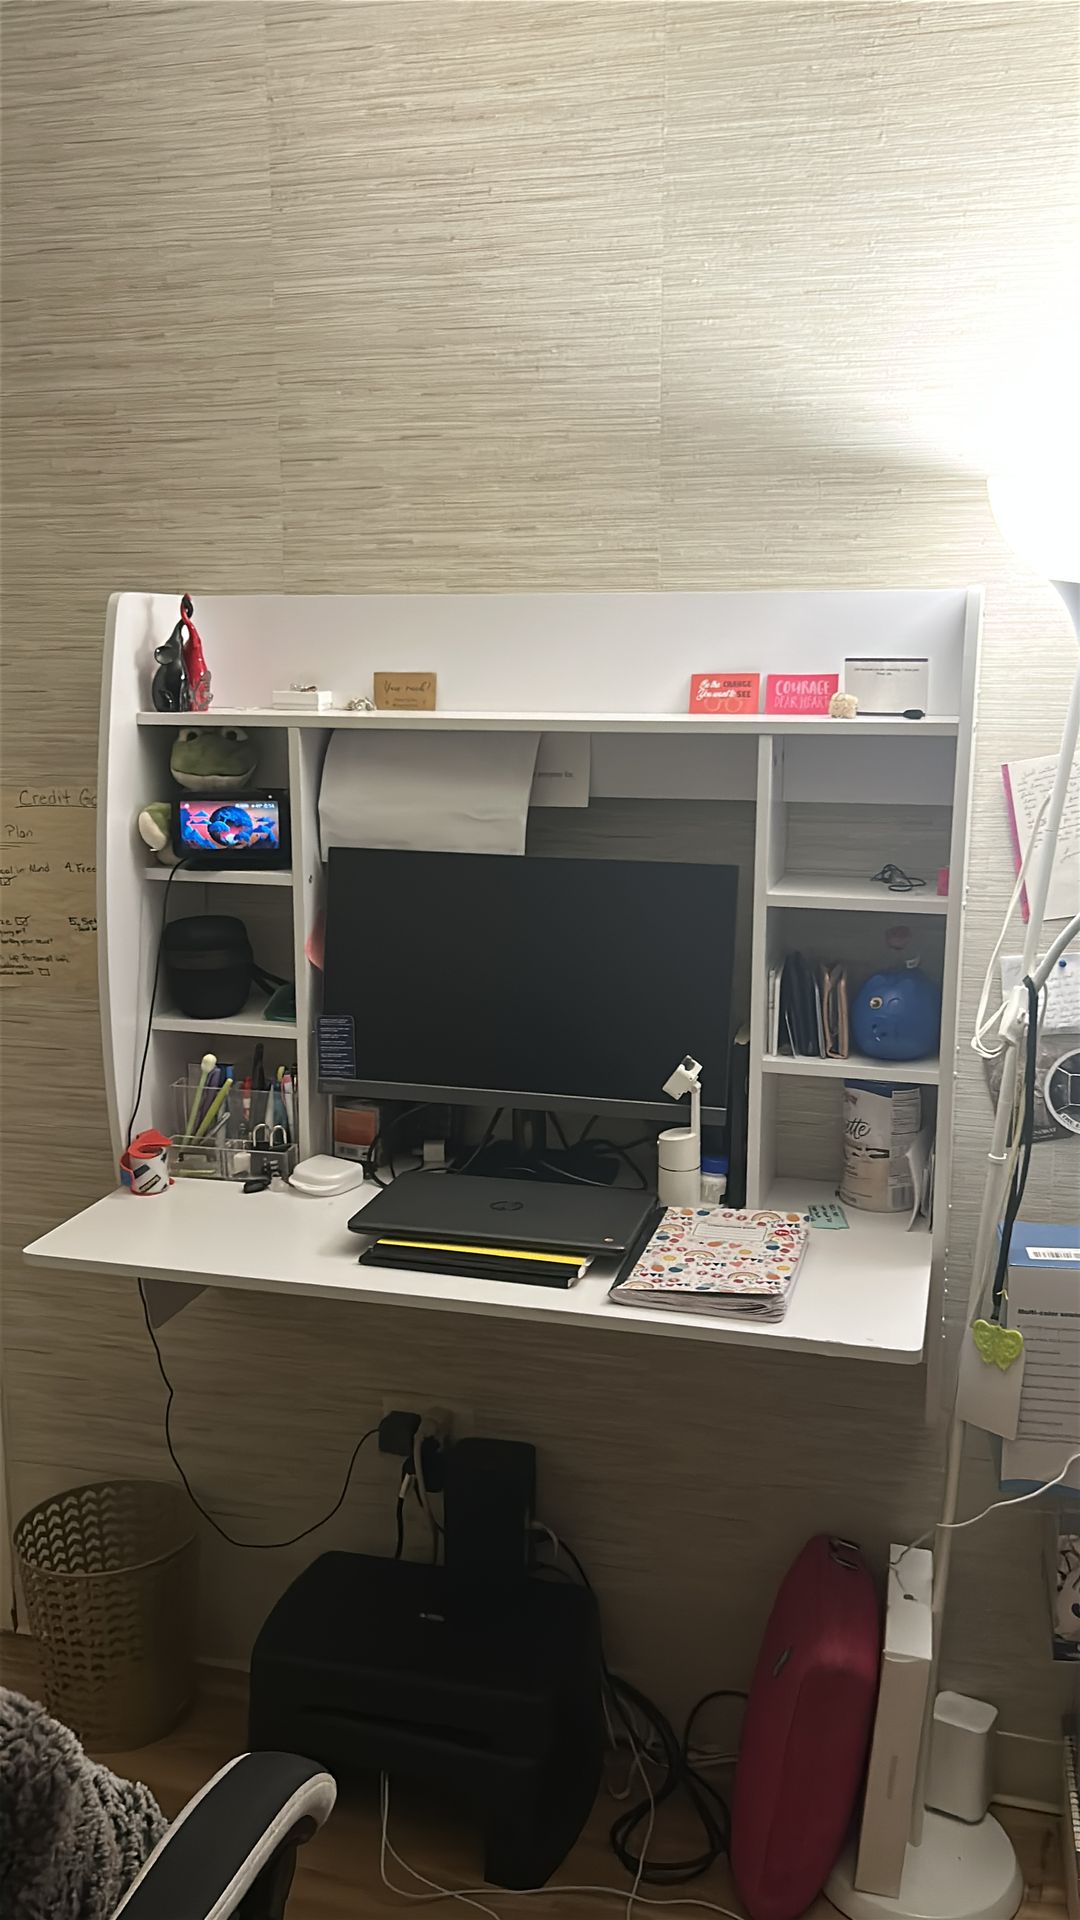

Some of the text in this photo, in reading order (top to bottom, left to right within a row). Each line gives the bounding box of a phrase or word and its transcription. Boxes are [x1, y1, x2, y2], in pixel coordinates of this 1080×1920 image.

[775, 680, 830, 696] COURAGE
[774, 695, 798, 709] DEAR
[19, 789, 71, 806] Credit
[4, 824, 33, 838] Plan
